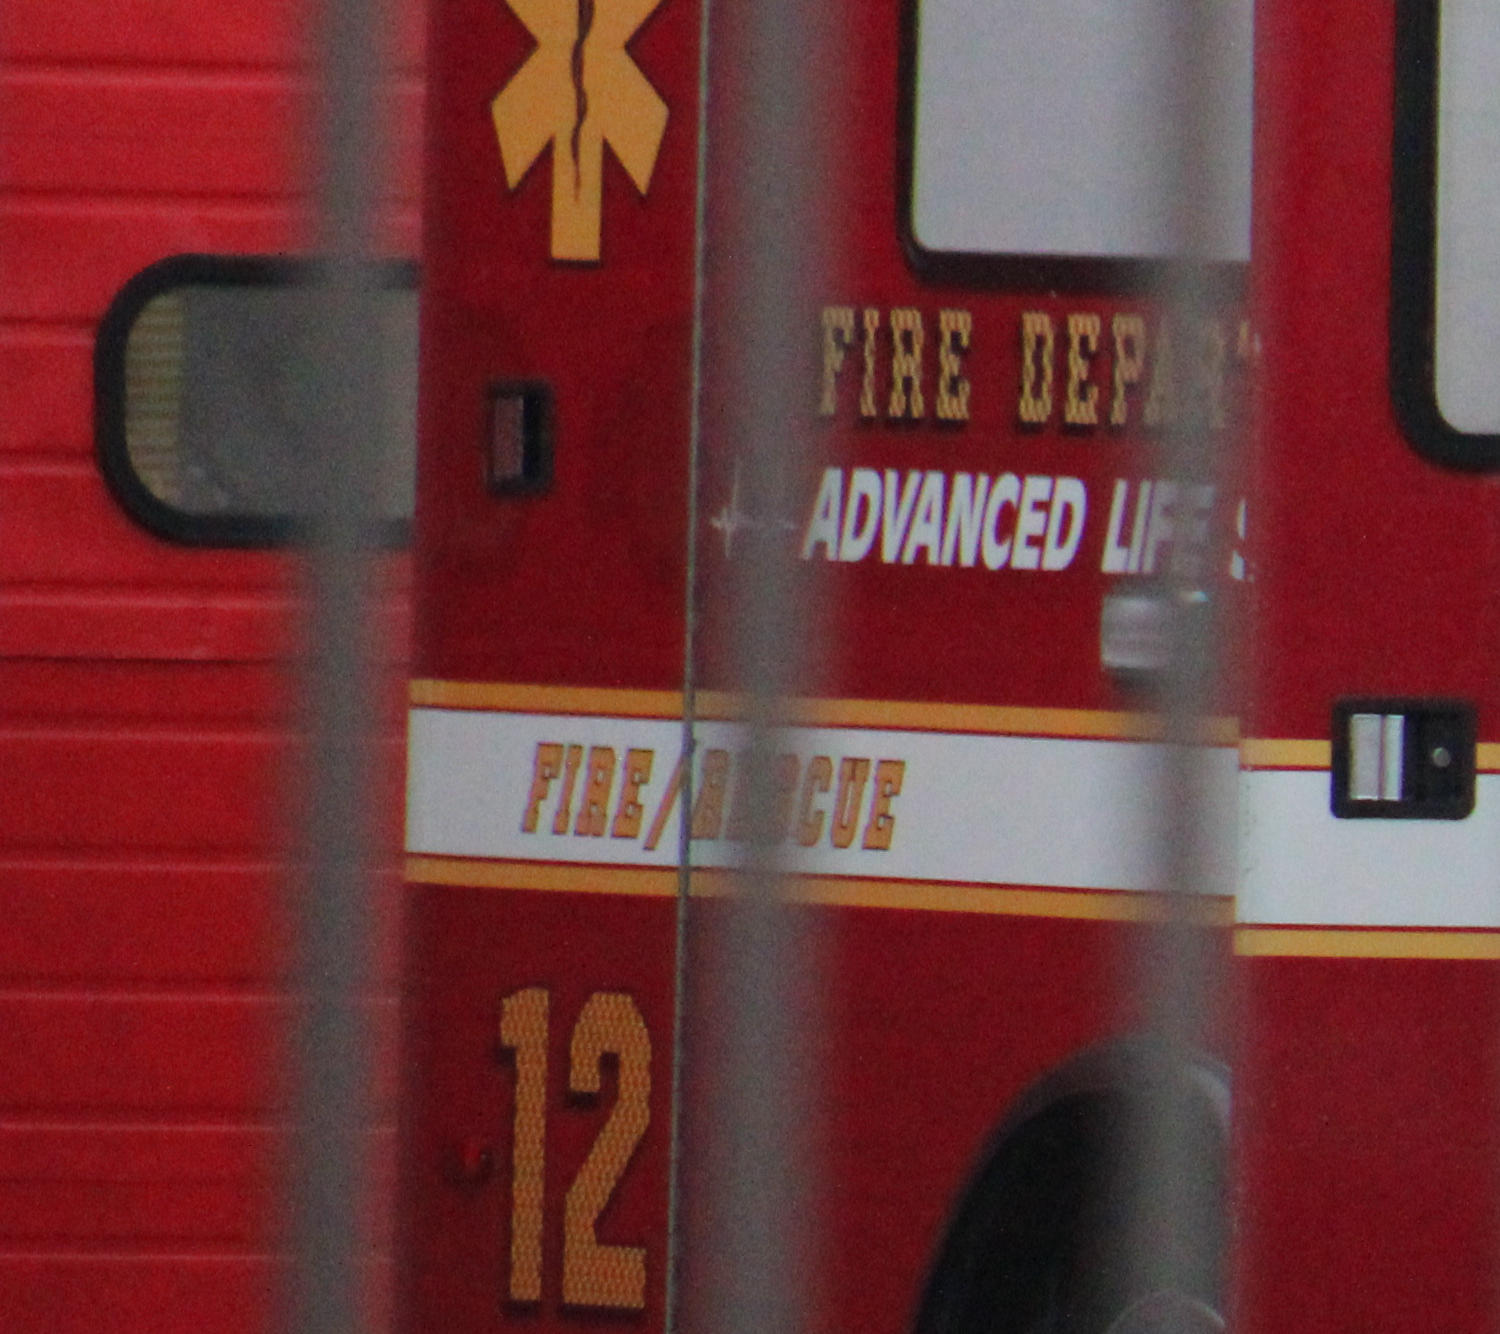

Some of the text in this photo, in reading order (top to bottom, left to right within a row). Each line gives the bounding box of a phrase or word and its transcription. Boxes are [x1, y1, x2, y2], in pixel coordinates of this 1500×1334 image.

[818, 306, 973, 421] FIRE
[803, 466, 1089, 571] ADVANCED
[499, 986, 652, 1310] 12
